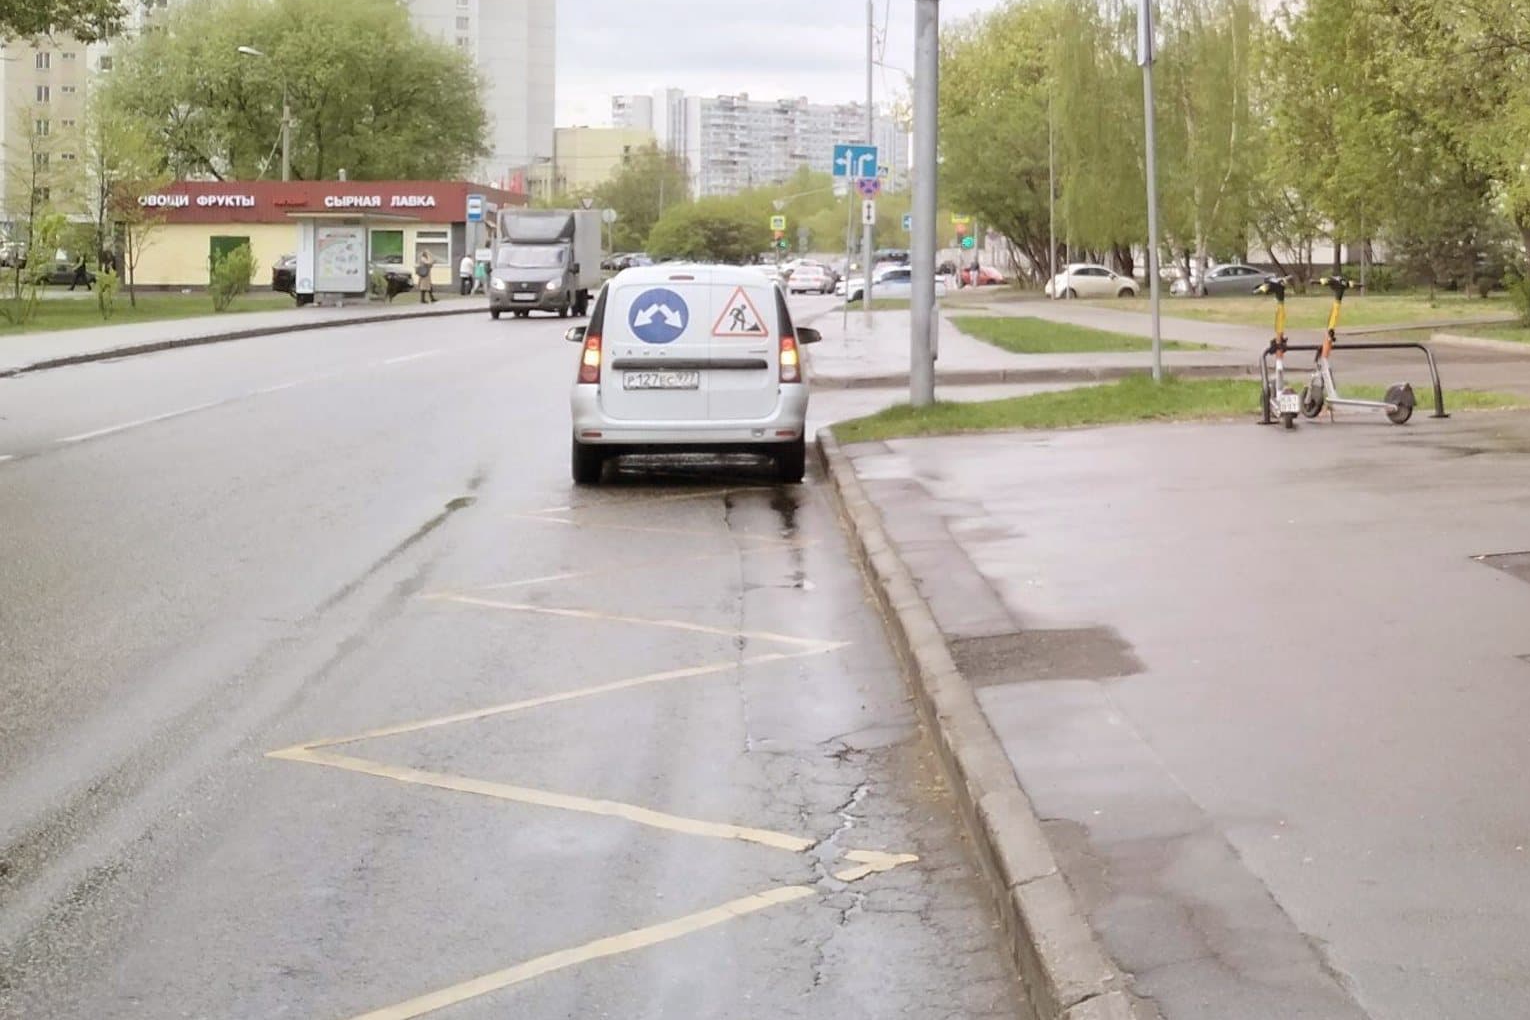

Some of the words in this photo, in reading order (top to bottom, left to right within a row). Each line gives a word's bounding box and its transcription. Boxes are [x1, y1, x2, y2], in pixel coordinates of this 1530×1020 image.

[137, 194, 190, 208] ОВОЩИ
[196, 194, 255, 207] ФРУКТЫ
[324, 195, 382, 208] СЫРНАЯ
[390, 195, 436, 207] ЛАВКА
